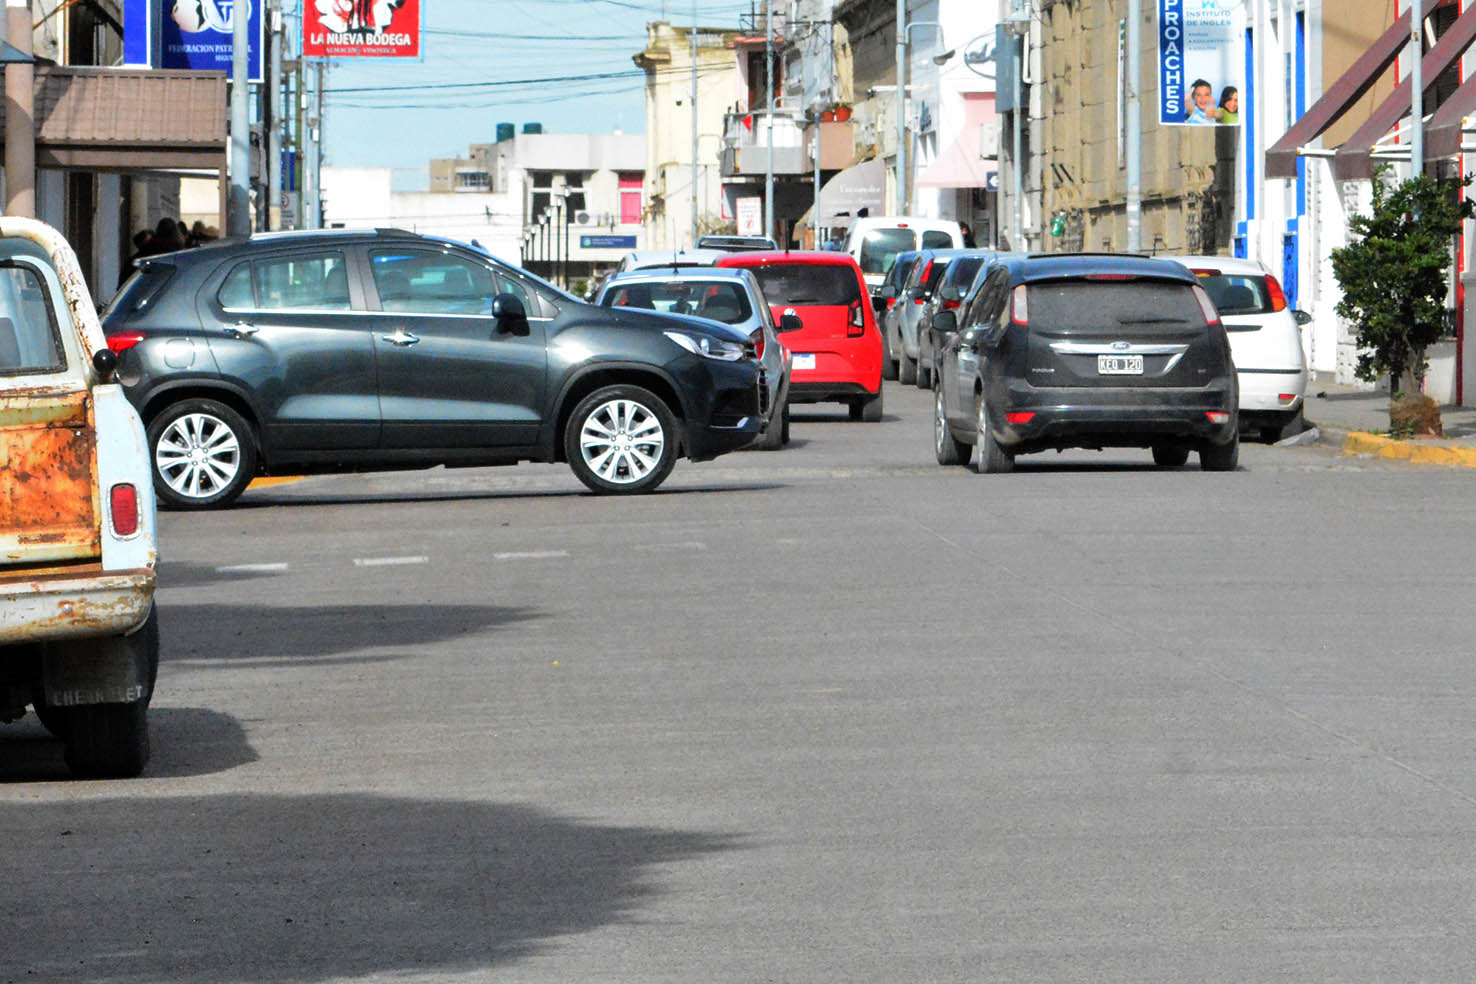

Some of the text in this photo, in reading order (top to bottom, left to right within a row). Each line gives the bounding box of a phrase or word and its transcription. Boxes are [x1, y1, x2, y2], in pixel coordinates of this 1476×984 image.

[310, 33, 411, 46] LA NUEVA BODEGA
[215, 44, 252, 53] PATRL
